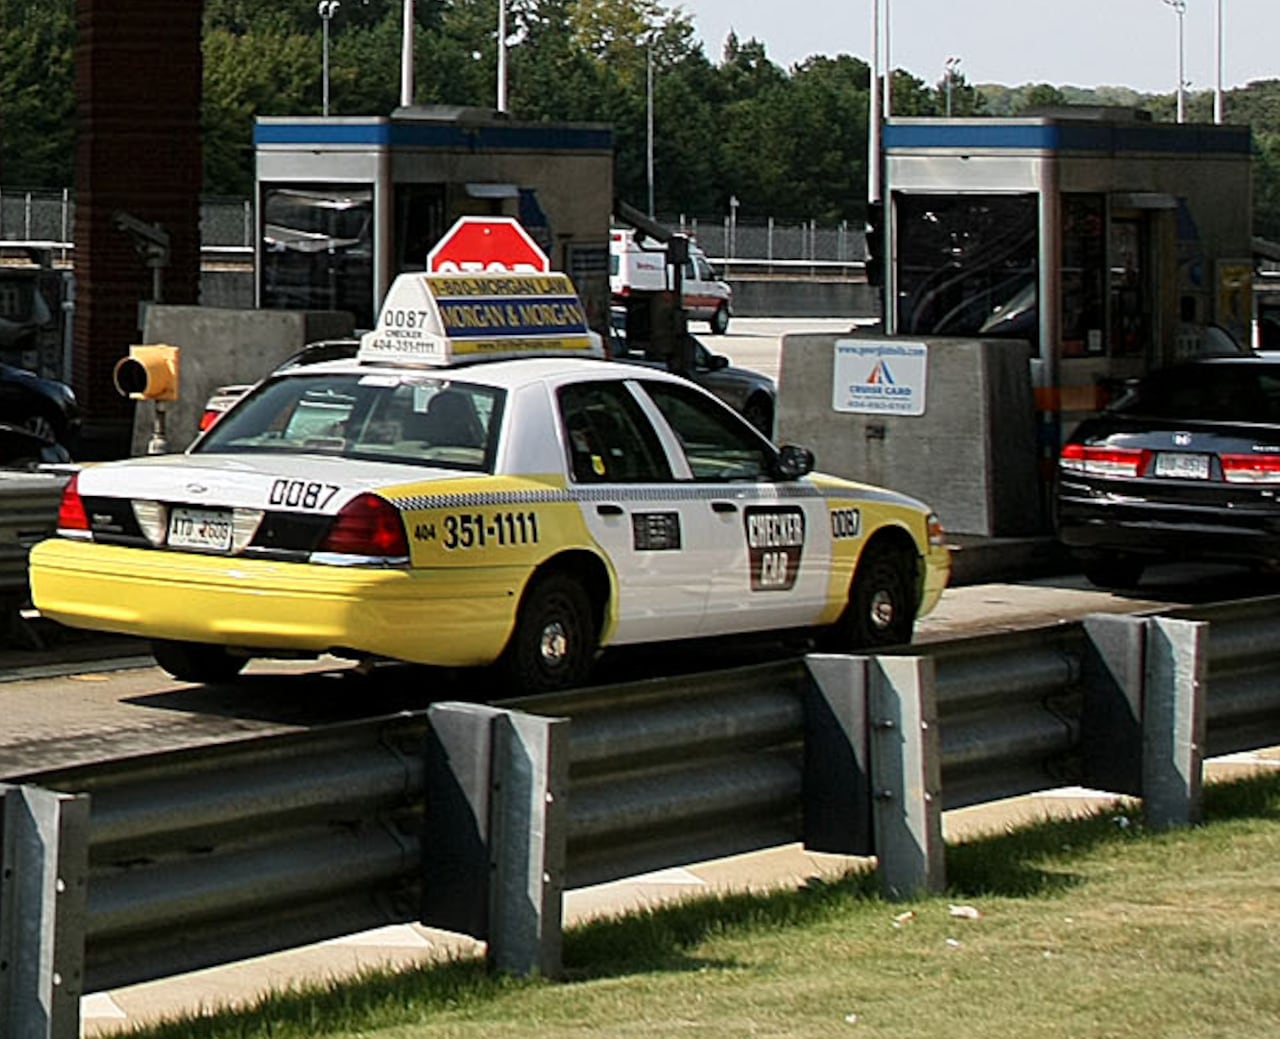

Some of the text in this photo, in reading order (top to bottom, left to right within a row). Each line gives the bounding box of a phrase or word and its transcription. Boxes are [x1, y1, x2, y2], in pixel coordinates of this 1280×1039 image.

[385, 310, 427, 328] 0087
[440, 304, 505, 328] MORGAN
[519, 303, 584, 326] MORGAN
[269, 480, 341, 510] 0087
[414, 512, 539, 549] 404 351-1111
[748, 514, 803, 548] CHECKER
[761, 552, 789, 585] CAB
